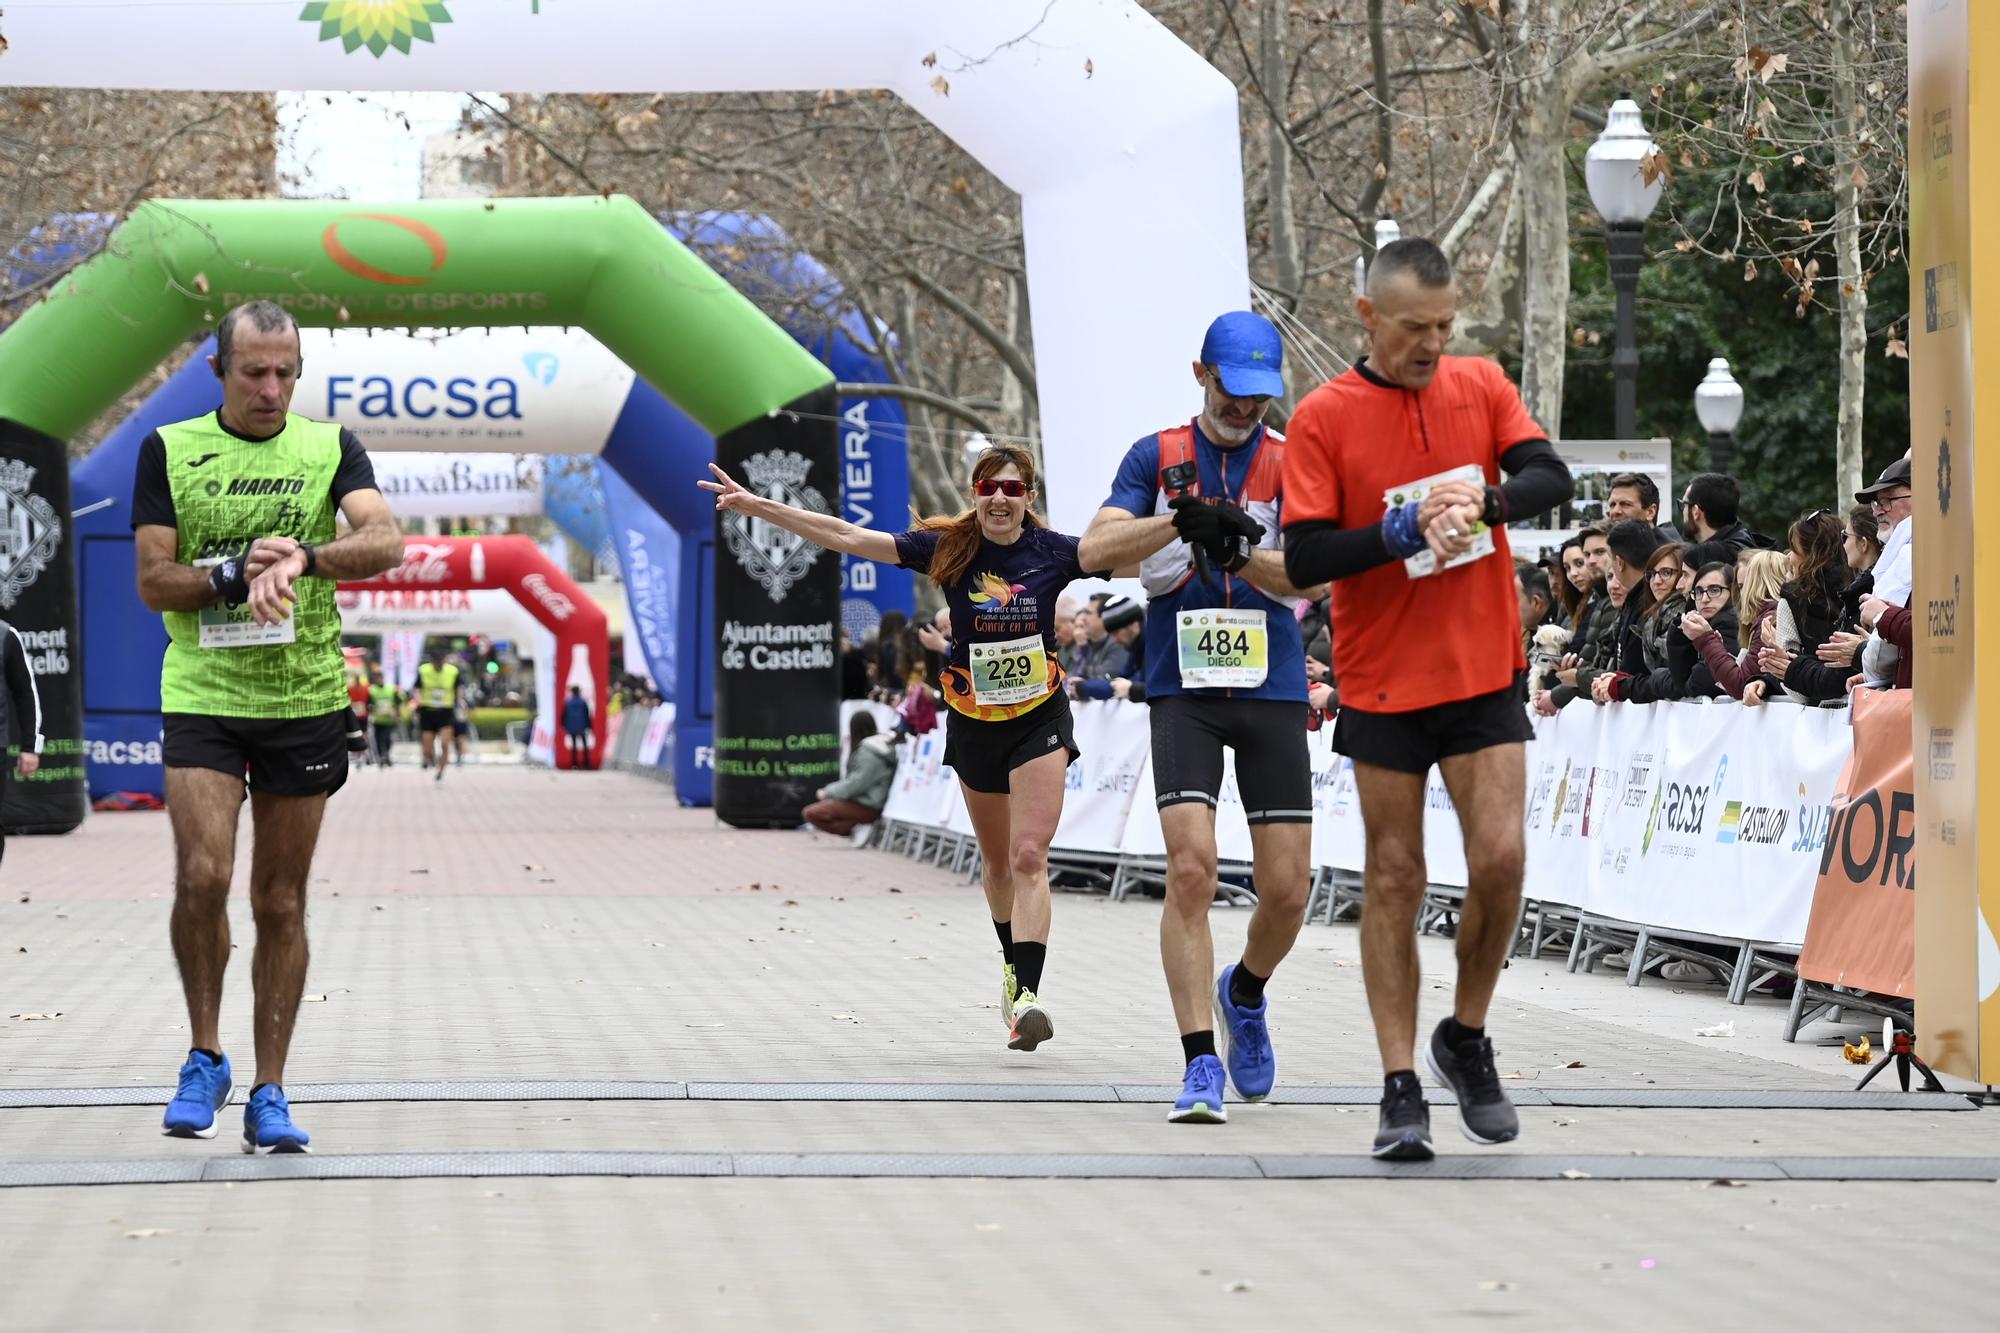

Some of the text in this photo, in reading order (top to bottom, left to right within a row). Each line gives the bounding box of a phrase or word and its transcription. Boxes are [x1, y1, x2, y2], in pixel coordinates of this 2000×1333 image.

[385, 292, 547, 310] D'ESPORTS
[326, 375, 523, 419] Facsa
[226, 474, 305, 496] MARATÓ
[844, 400, 877, 591] BVIERA
[1928, 599, 1955, 638] Facsa
[721, 619, 833, 648] Ajuntament
[1197, 629, 1250, 656] 484
[722, 643, 834, 670] de Castelló
[987, 655, 1031, 681] 229
[1207, 656, 1242, 667] DIEGO
[998, 678, 1026, 689] ANITA
